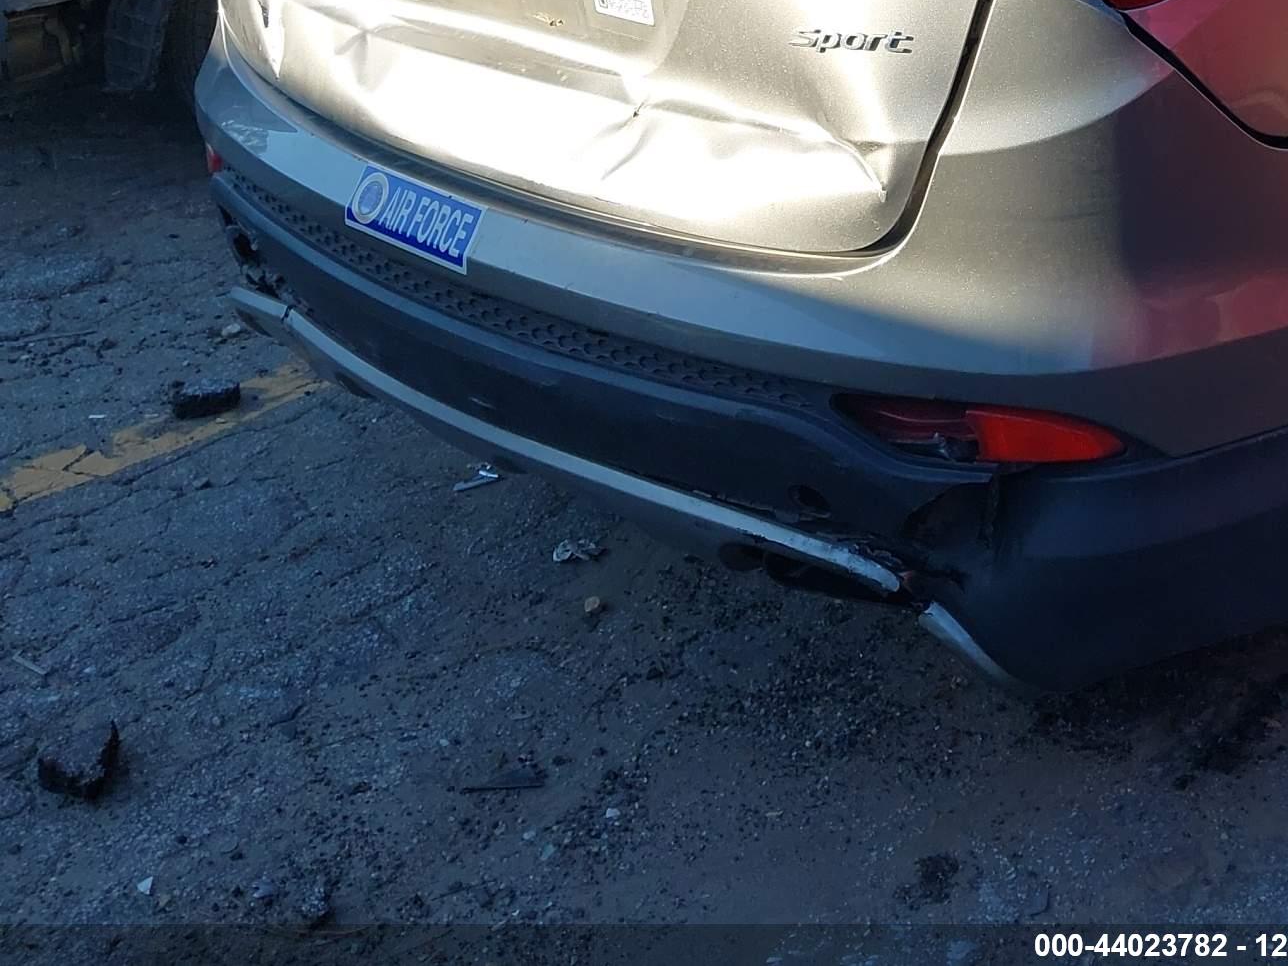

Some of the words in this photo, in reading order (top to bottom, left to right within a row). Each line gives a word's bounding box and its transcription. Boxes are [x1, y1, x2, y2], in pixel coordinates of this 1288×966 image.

[788, 27, 915, 54] Sport
[378, 185, 417, 235] AIR
[406, 195, 474, 259] FORCE
